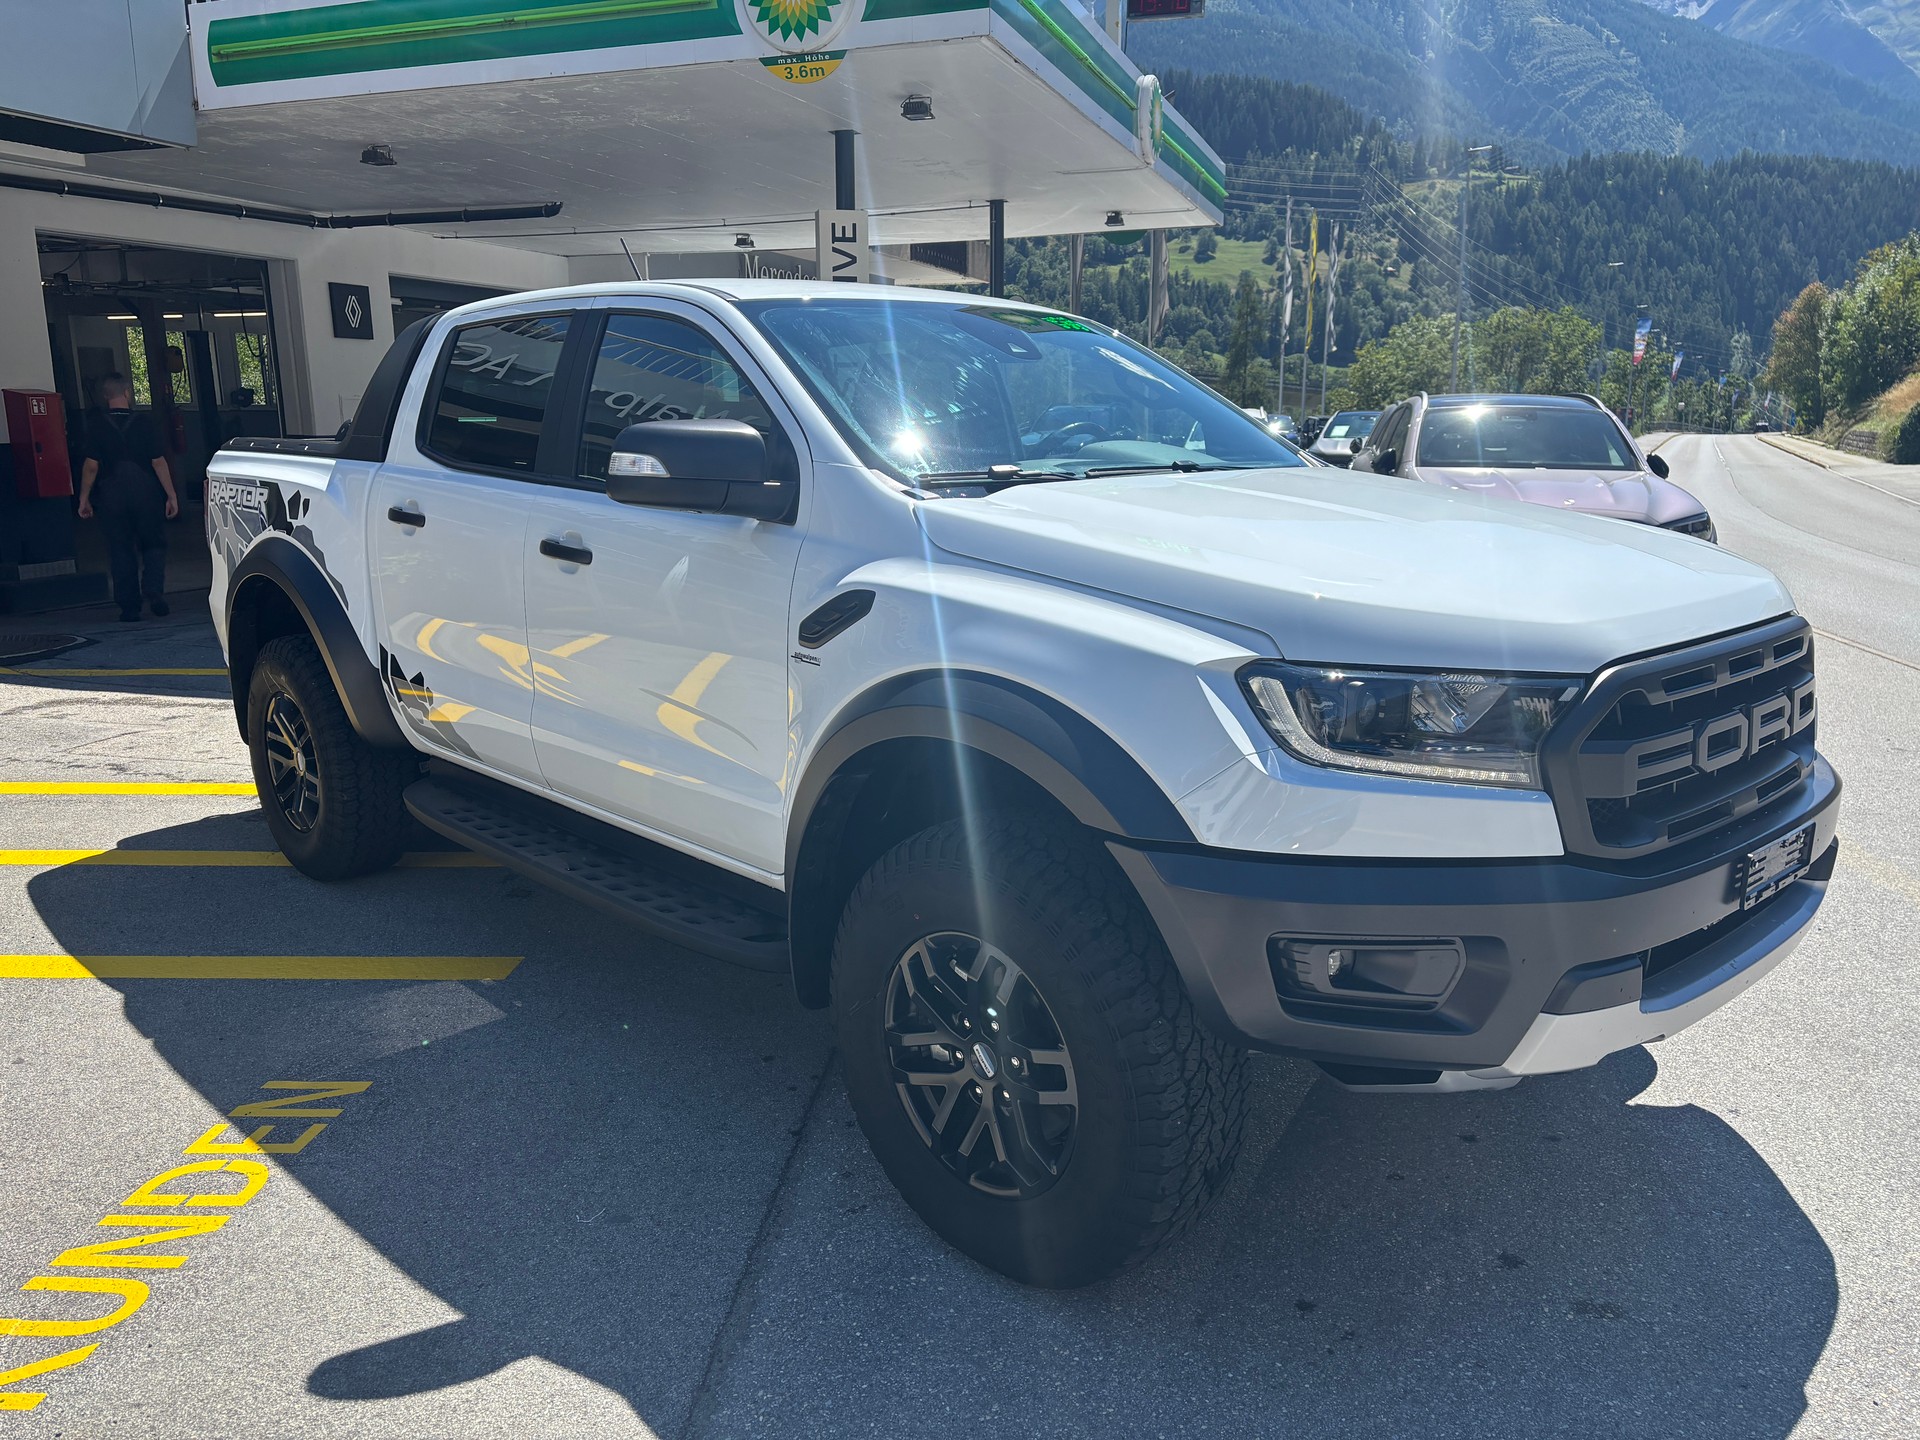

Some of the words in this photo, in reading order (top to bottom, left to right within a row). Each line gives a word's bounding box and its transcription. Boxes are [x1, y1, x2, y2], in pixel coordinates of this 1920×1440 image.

[804, 53, 830, 62] Höhe
[783, 65, 826, 80] 3.6m
[743, 252, 819, 280] Merced
[210, 480, 269, 513] RAPTOR
[1624, 678, 1815, 797] FORD
[975, 1048, 991, 1074] FORD
